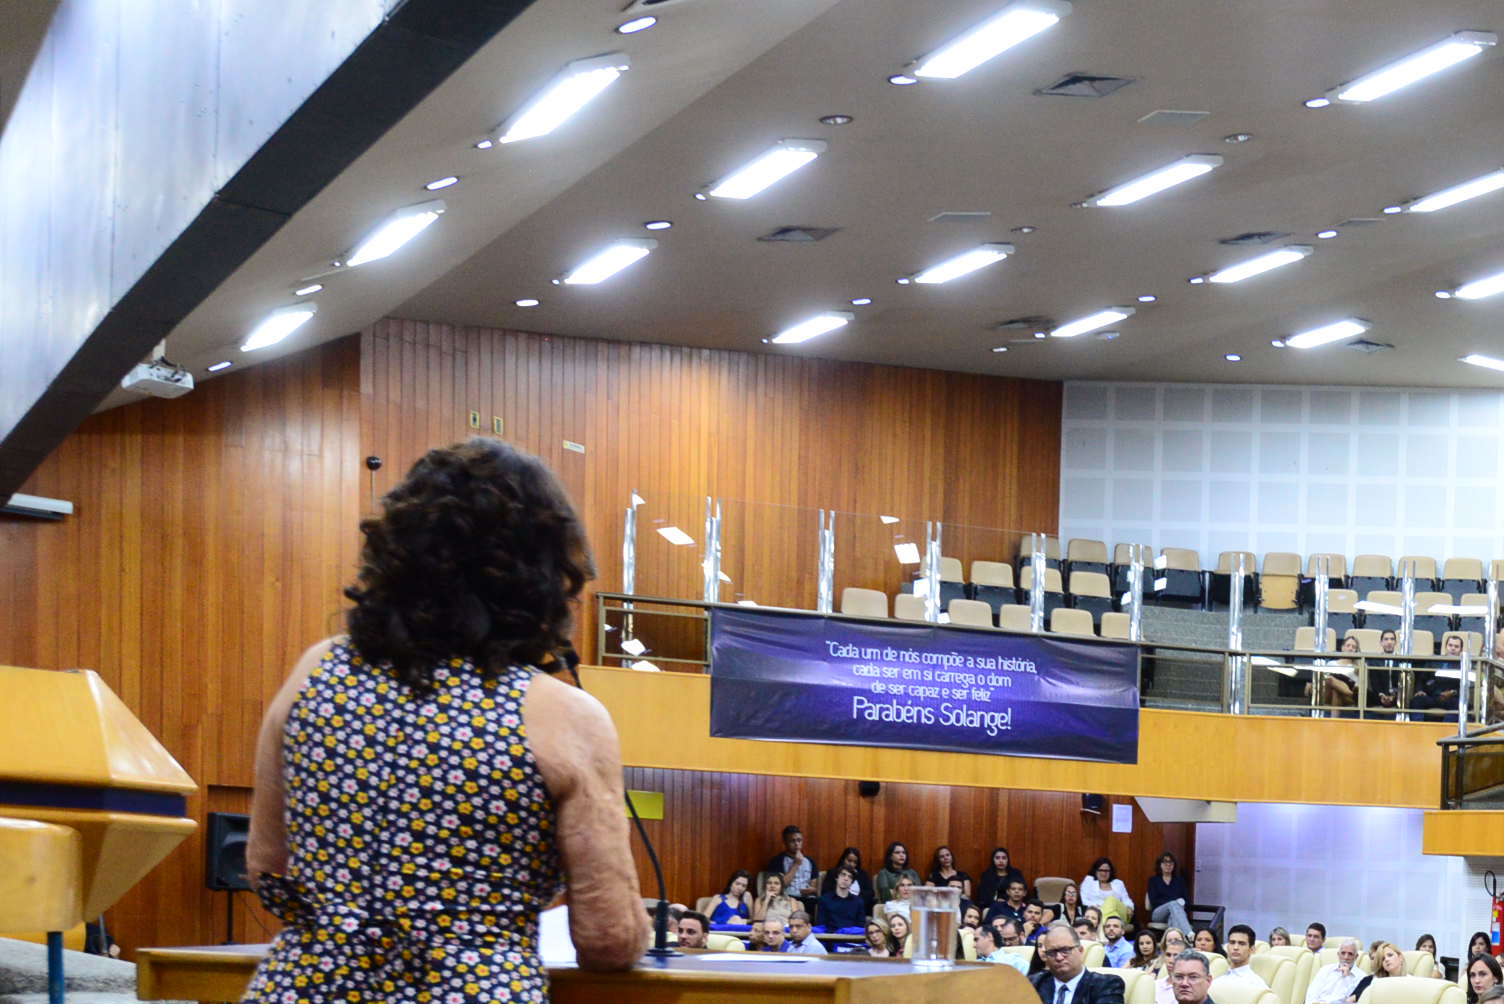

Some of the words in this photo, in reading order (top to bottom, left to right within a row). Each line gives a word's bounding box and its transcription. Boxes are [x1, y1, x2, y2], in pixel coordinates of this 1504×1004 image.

[861, 648, 880, 660] um
[883, 646, 898, 661] de
[900, 648, 920, 663] nós
[922, 651, 964, 670] compõe
[966, 656, 974, 668] a
[976, 657, 996, 669] sua
[853, 662, 880, 677] cada
[881, 666, 900, 679] ser
[902, 668, 921, 680] em
[923, 669, 932, 681] si
[935, 671, 975, 688] carrega
[977, 674, 985, 686] o
[987, 672, 1012, 687] dom
[871, 680, 887, 694] de
[887, 684, 906, 695] ser
[908, 685, 940, 700] capaz
[942, 688, 950, 699] e
[951, 688, 969, 700] ser
[852, 695, 935, 725] Parabéns
[939, 702, 1012, 737] Solange!
